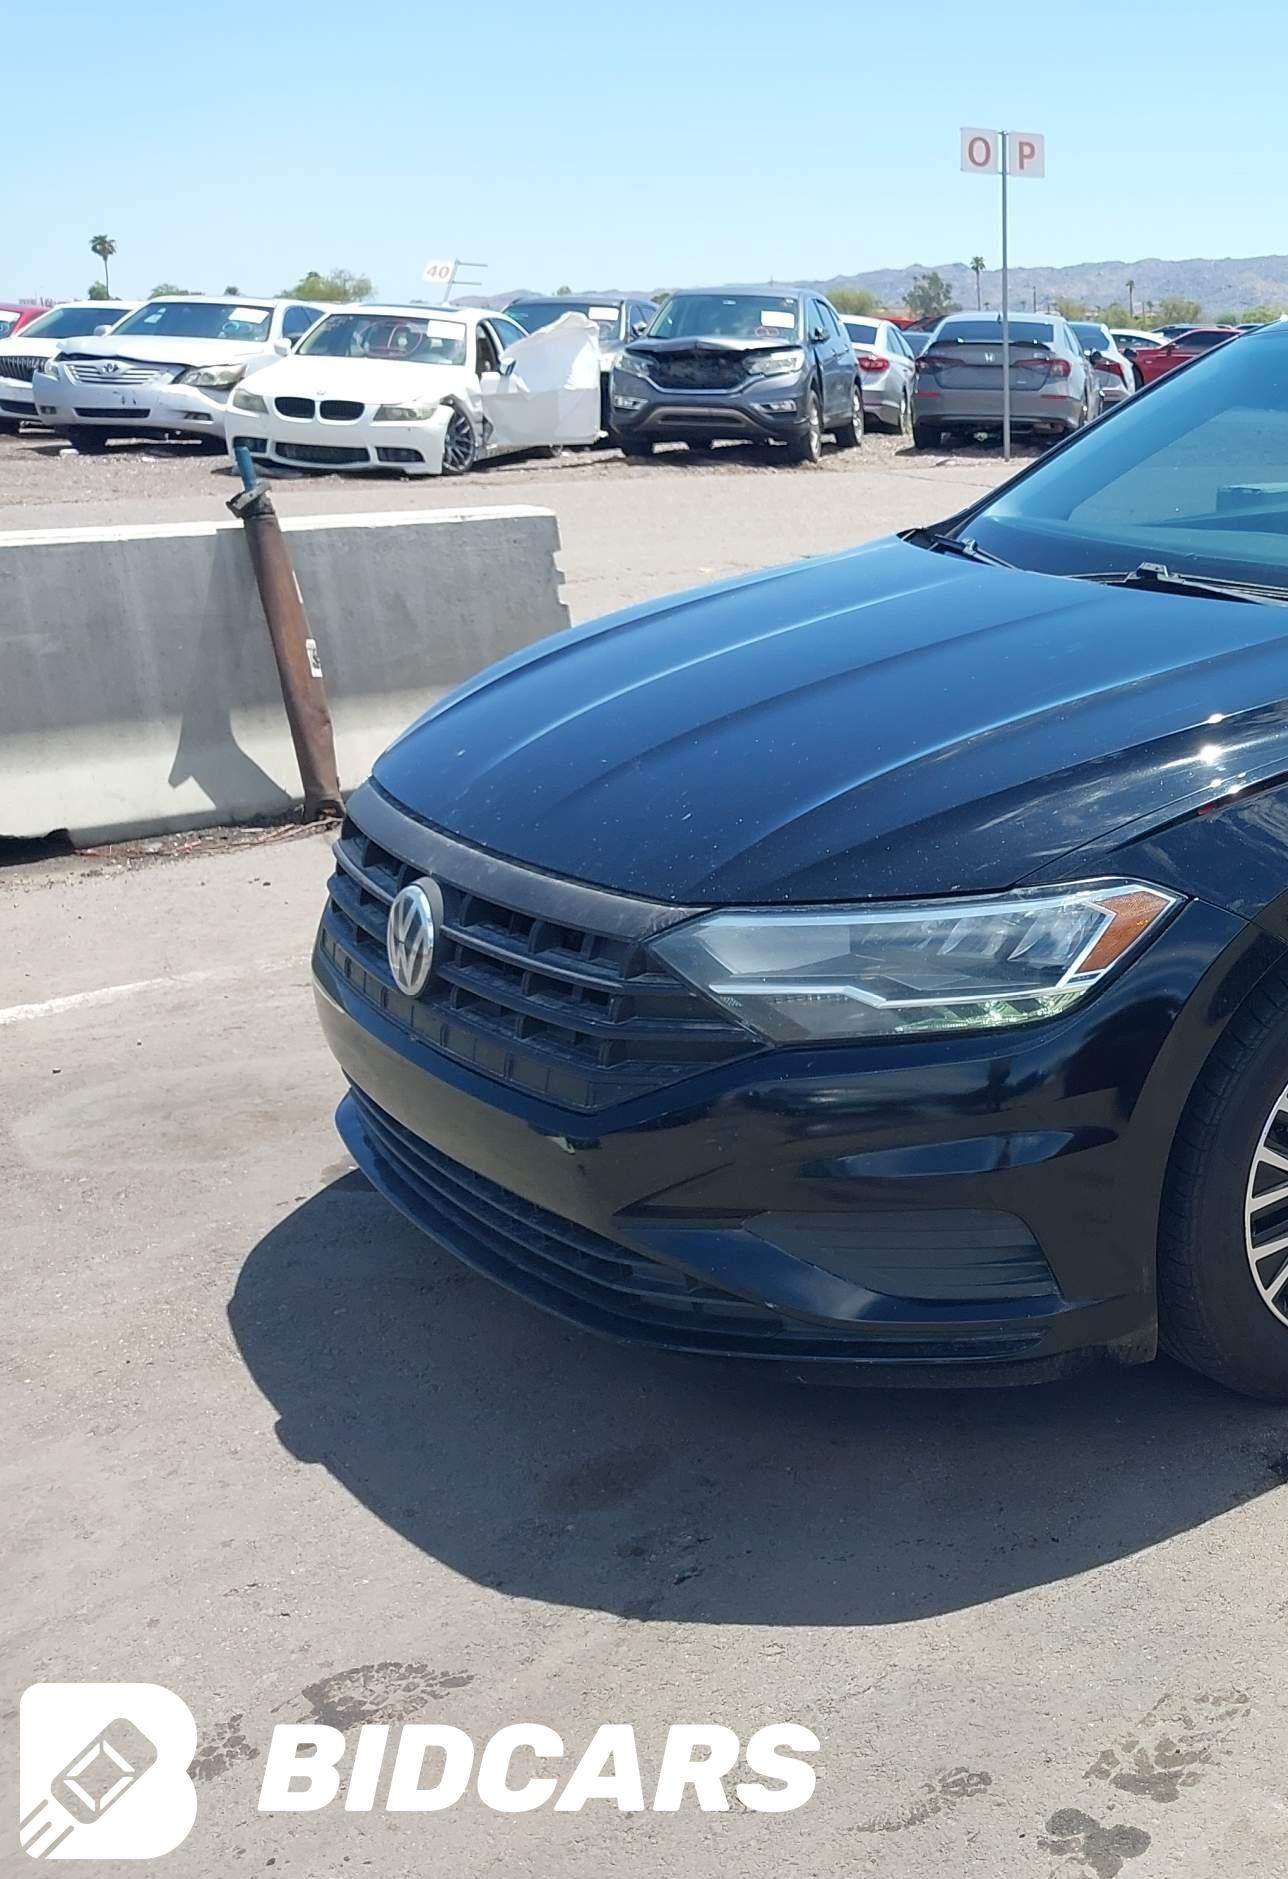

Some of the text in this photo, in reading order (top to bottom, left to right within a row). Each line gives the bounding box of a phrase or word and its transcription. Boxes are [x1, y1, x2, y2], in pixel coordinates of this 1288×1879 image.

[968, 136, 991, 167] O
[1018, 141, 1036, 170] P
[426, 265, 450, 279] 40
